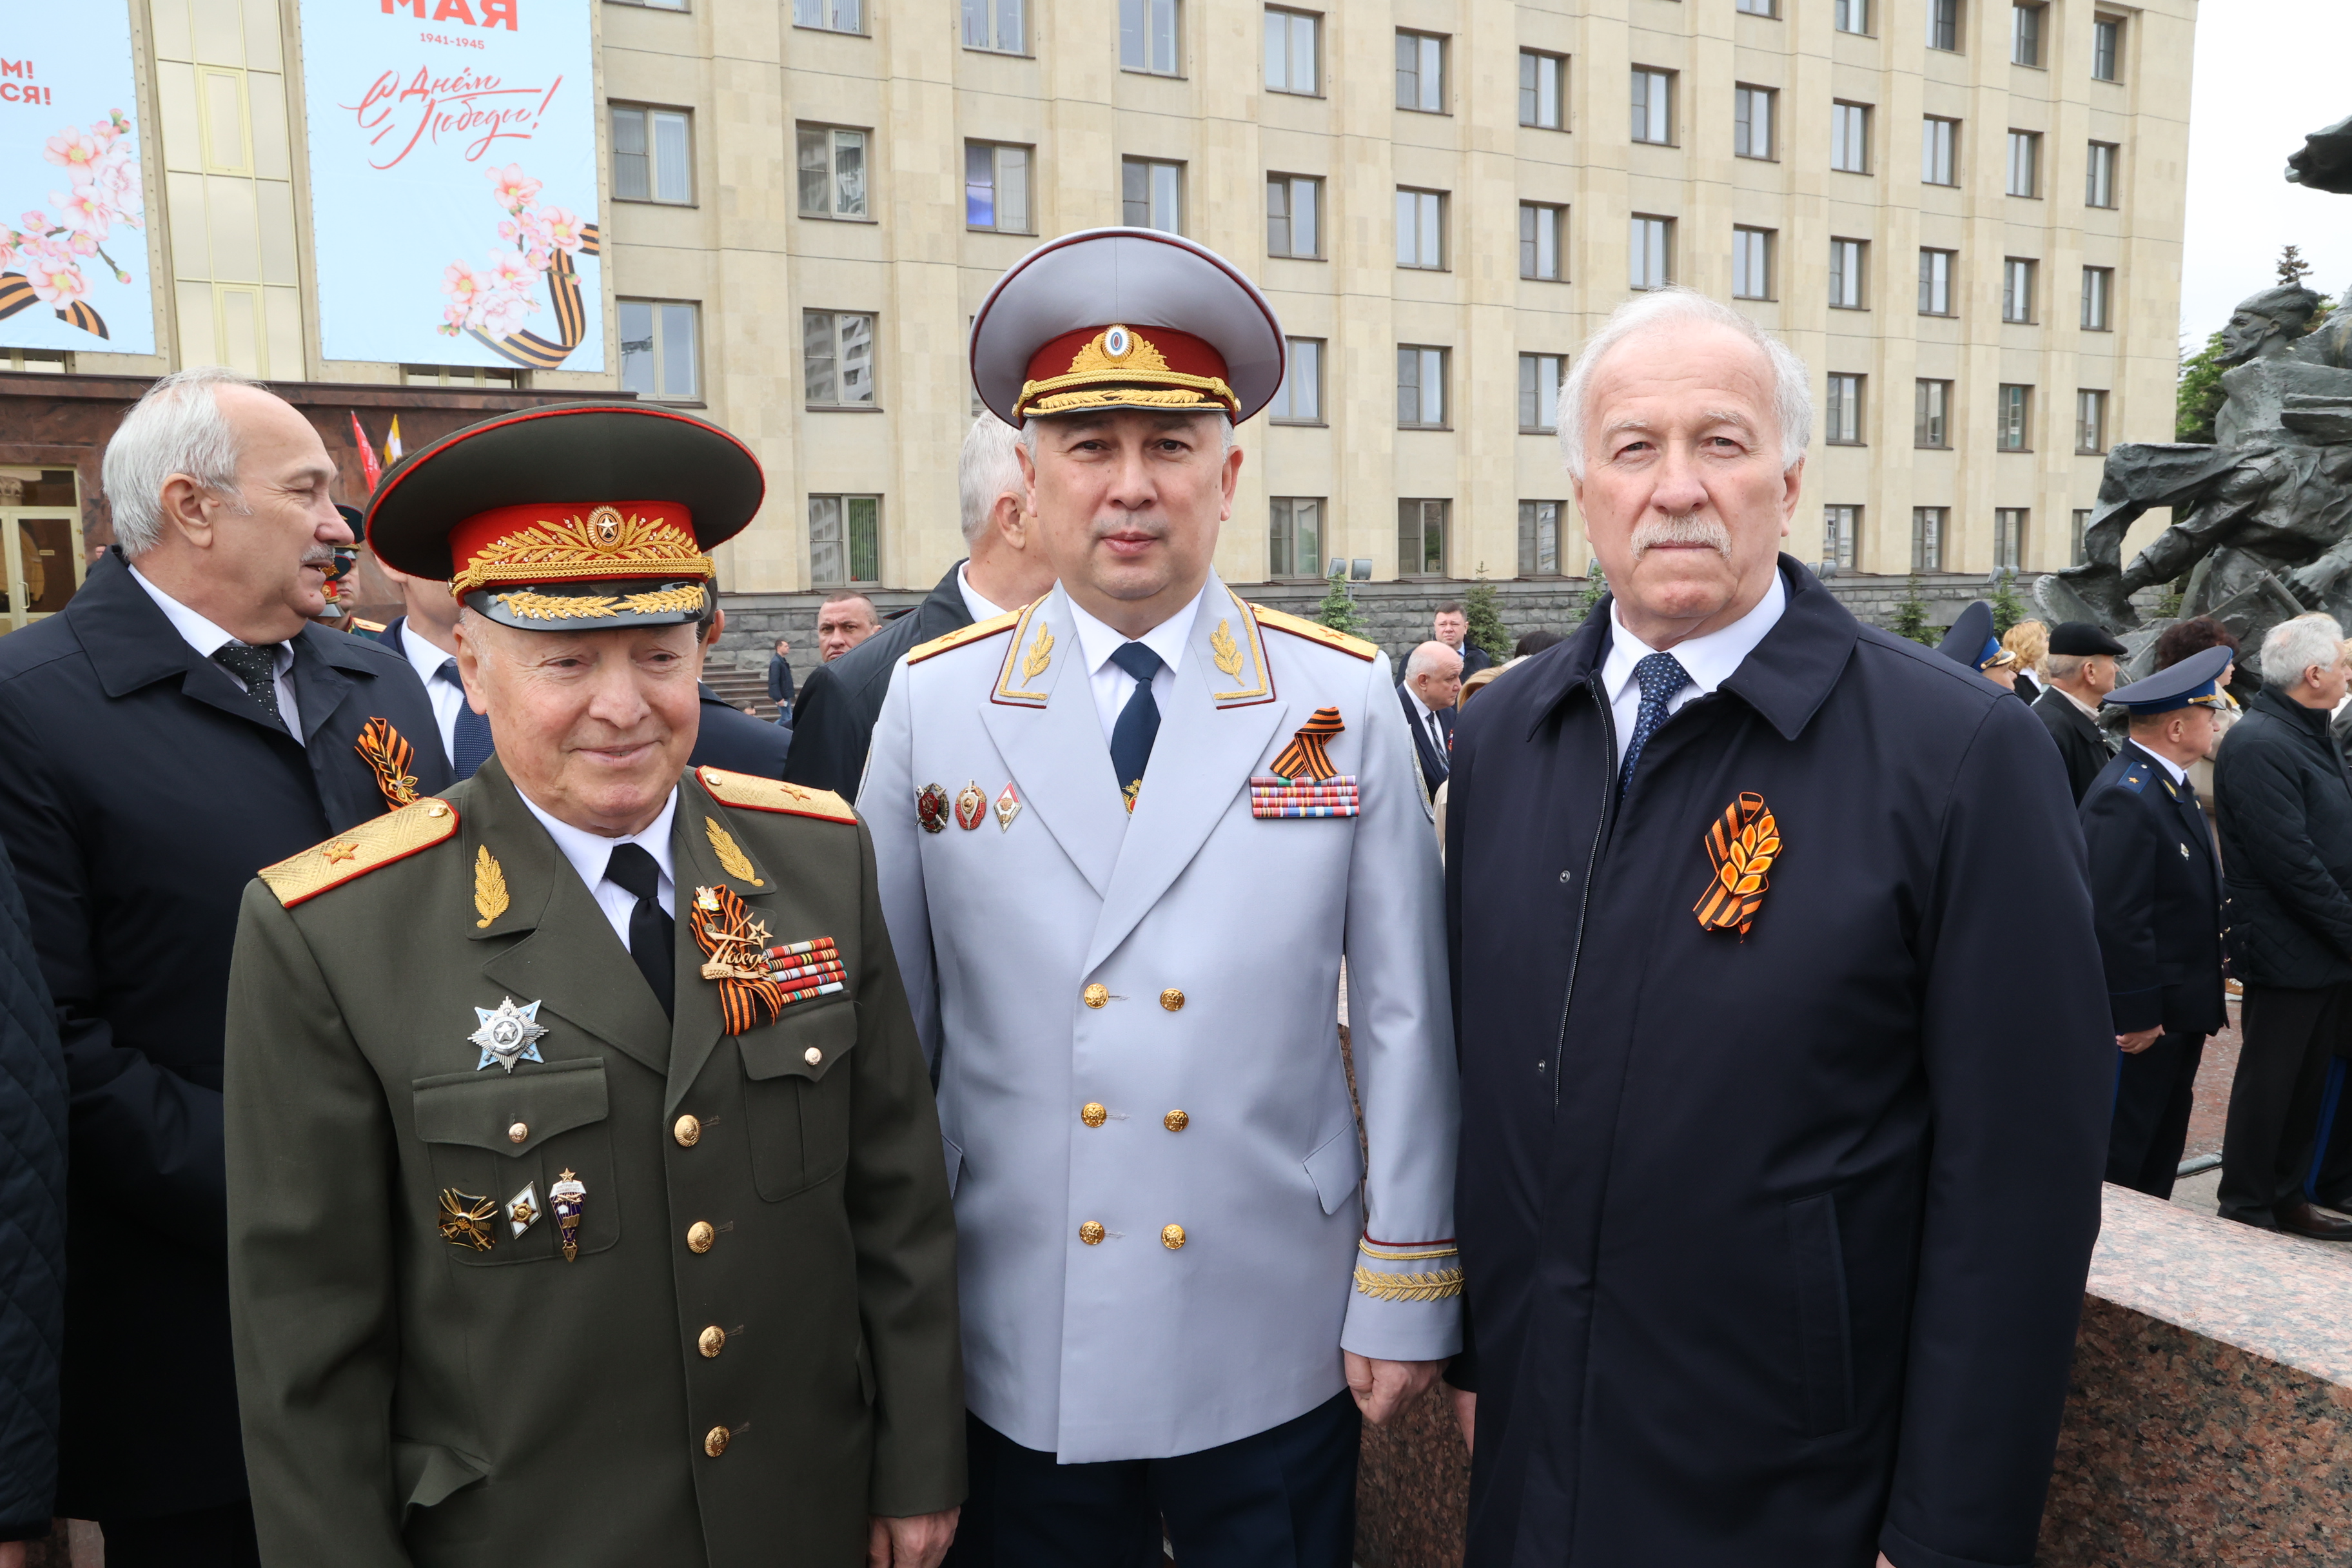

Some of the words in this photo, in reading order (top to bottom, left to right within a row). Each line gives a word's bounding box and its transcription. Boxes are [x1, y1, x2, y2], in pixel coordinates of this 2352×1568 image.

[420, 32, 485, 50] 1941-1945
[0, 57, 34, 79] М!
[0, 83, 52, 106] СЯ!
